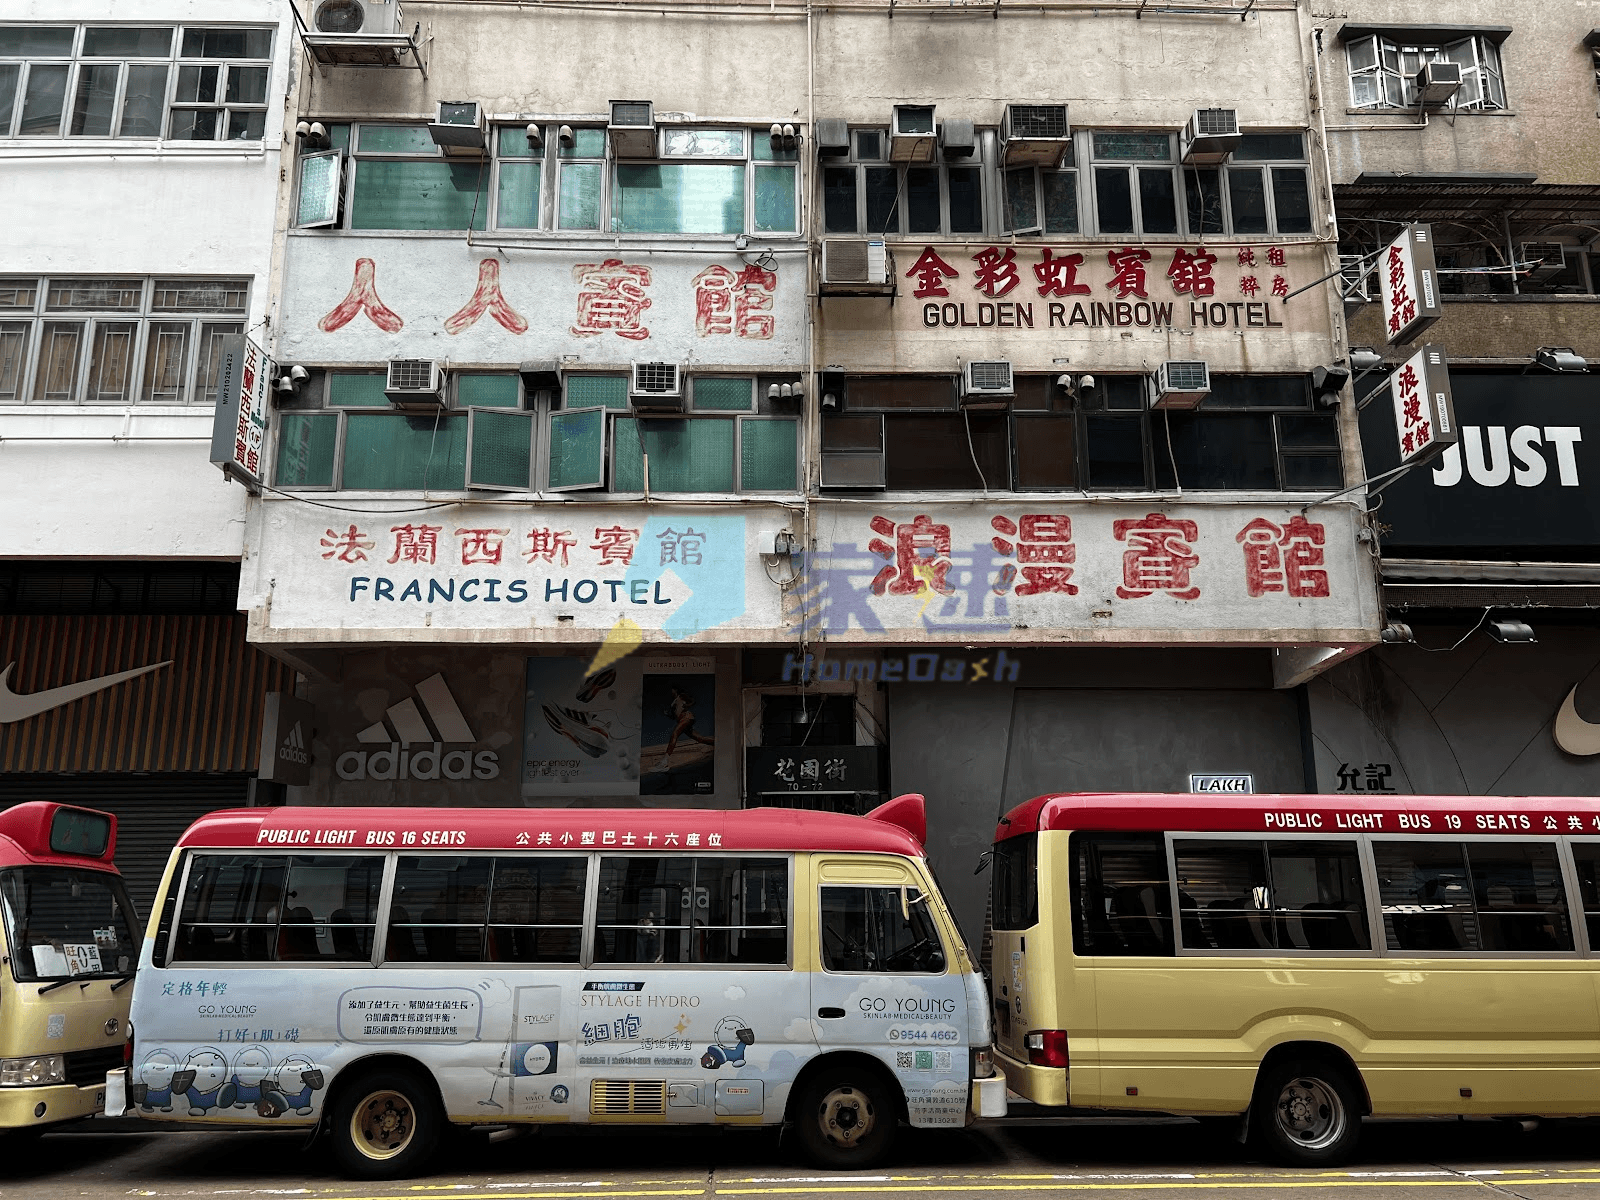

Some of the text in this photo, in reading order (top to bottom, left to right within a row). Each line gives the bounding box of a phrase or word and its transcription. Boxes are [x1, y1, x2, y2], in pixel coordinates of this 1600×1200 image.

[905, 246, 1219, 299] 金彩虹賓館
[317, 257, 777, 340] 人人賓館
[1386, 245, 1416, 336] 金彩虹賓館
[922, 301, 1284, 328] GOLDEN RAINBOW HOTEL
[234, 343, 259, 475] 法蘭西斯賓館
[1398, 364, 1430, 456] 浪漫賓館
[1432, 425, 1582, 487] JUST
[320, 524, 707, 567] 法蘭西斯賓館
[867, 513, 1331, 600] 浪漫賓館
[349, 577, 671, 604] FRANCIS HOTEL
[279, 746, 308, 765] adidas
[335, 742, 500, 781] adidas
[526, 759, 581, 768] epic energy
[560, 769, 580, 777] ever
[773, 757, 848, 782] 花園街
[1335, 762, 1396, 791] 允記
[1197, 779, 1246, 792] LAKH
[1264, 811, 1531, 831] PUBLIC LIGHT BUS 19 SEATS
[257, 829, 467, 846] PUBLIC LIGHT BUS 16 SEATS
[515, 831, 722, 846] 公共小型巴士十六座位
[65, 946, 80, 974] 旺角
[161, 980, 228, 997] 定格年輕
[581, 995, 700, 1008] STYLAGE HYDRO
[198, 1005, 257, 1014] GO YOUNG
[859, 997, 956, 1012] GO YOUNG
[581, 1013, 642, 1046] 細胞
[901, 1030, 958, 1040] 9544 4662
